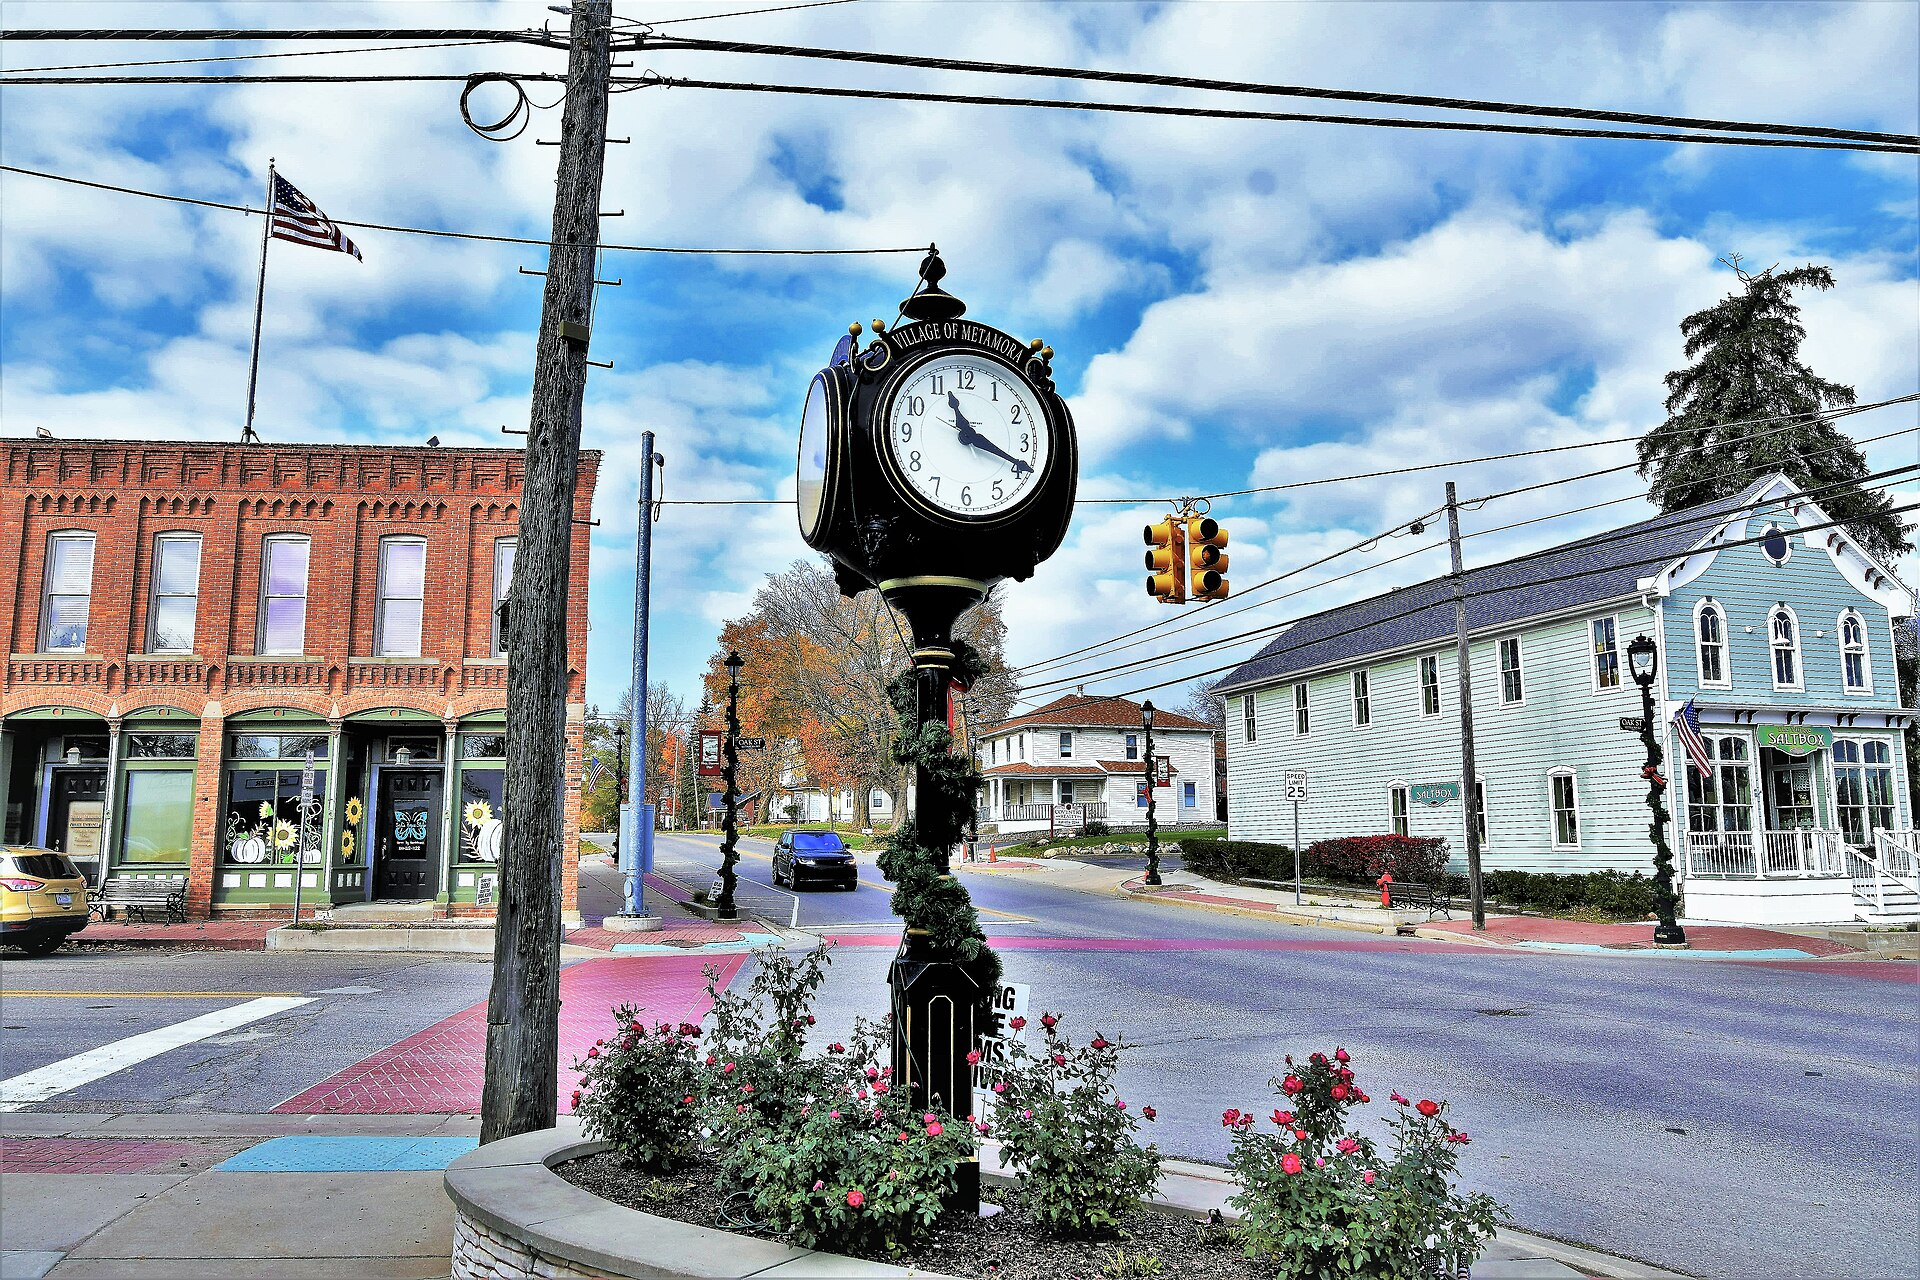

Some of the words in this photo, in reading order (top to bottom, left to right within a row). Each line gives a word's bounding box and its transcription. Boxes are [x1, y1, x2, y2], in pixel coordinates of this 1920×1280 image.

[892, 322, 941, 349] VILLAGE
[944, 322, 958, 339] OF
[961, 325, 1024, 363] METAMORA
[930, 375, 945, 395] 11
[957, 370, 976, 390] 12
[991, 382, 998, 401] 1
[907, 396, 924, 416] 10
[1011, 405, 1022, 424] 2
[901, 422, 912, 442] 9
[1020, 433, 1029, 452] 3
[910, 451, 921, 471] 8
[1011, 461, 1022, 479] 4
[929, 476, 940, 497] 7
[961, 486, 972, 506] 6
[992, 479, 1003, 500] 5
[1768, 733, 1825, 746] SALTBOX
[1287, 786, 1305, 798] 25
[1416, 789, 1453, 800] SALTBOX
